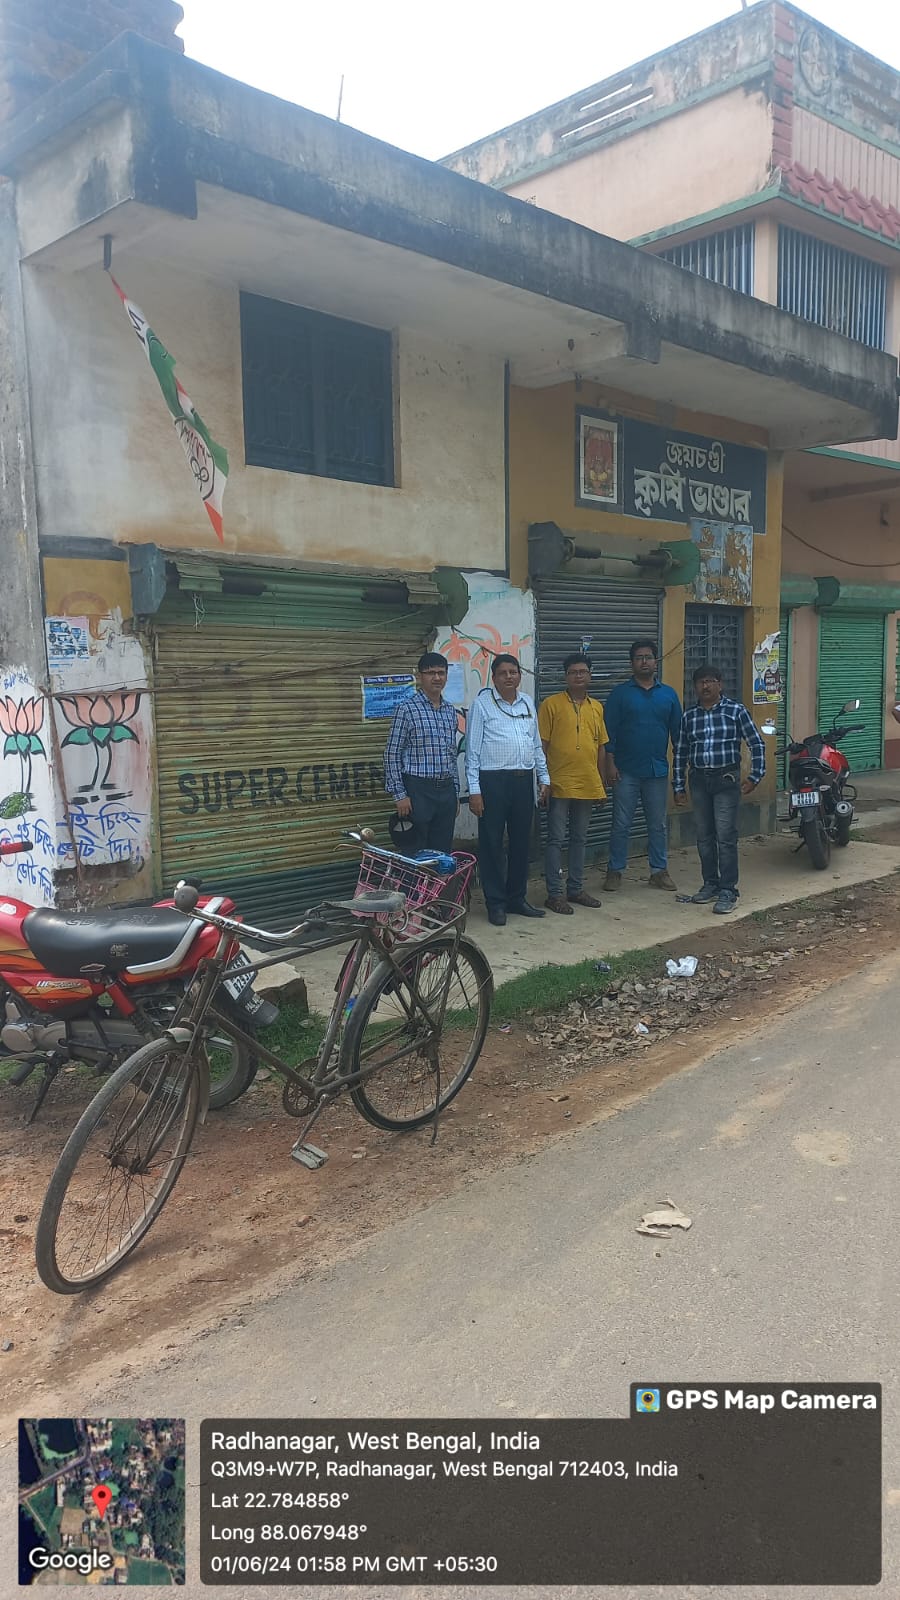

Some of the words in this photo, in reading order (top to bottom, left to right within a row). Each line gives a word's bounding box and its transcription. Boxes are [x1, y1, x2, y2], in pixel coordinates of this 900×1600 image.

[666, 440, 726, 473] জয়চণ্ডী
[634, 462, 687, 517] কৃষি
[688, 478, 752, 523] ভাণ্ডার
[178, 766, 290, 815] SUPER
[297, 761, 385, 801] CEMEN
